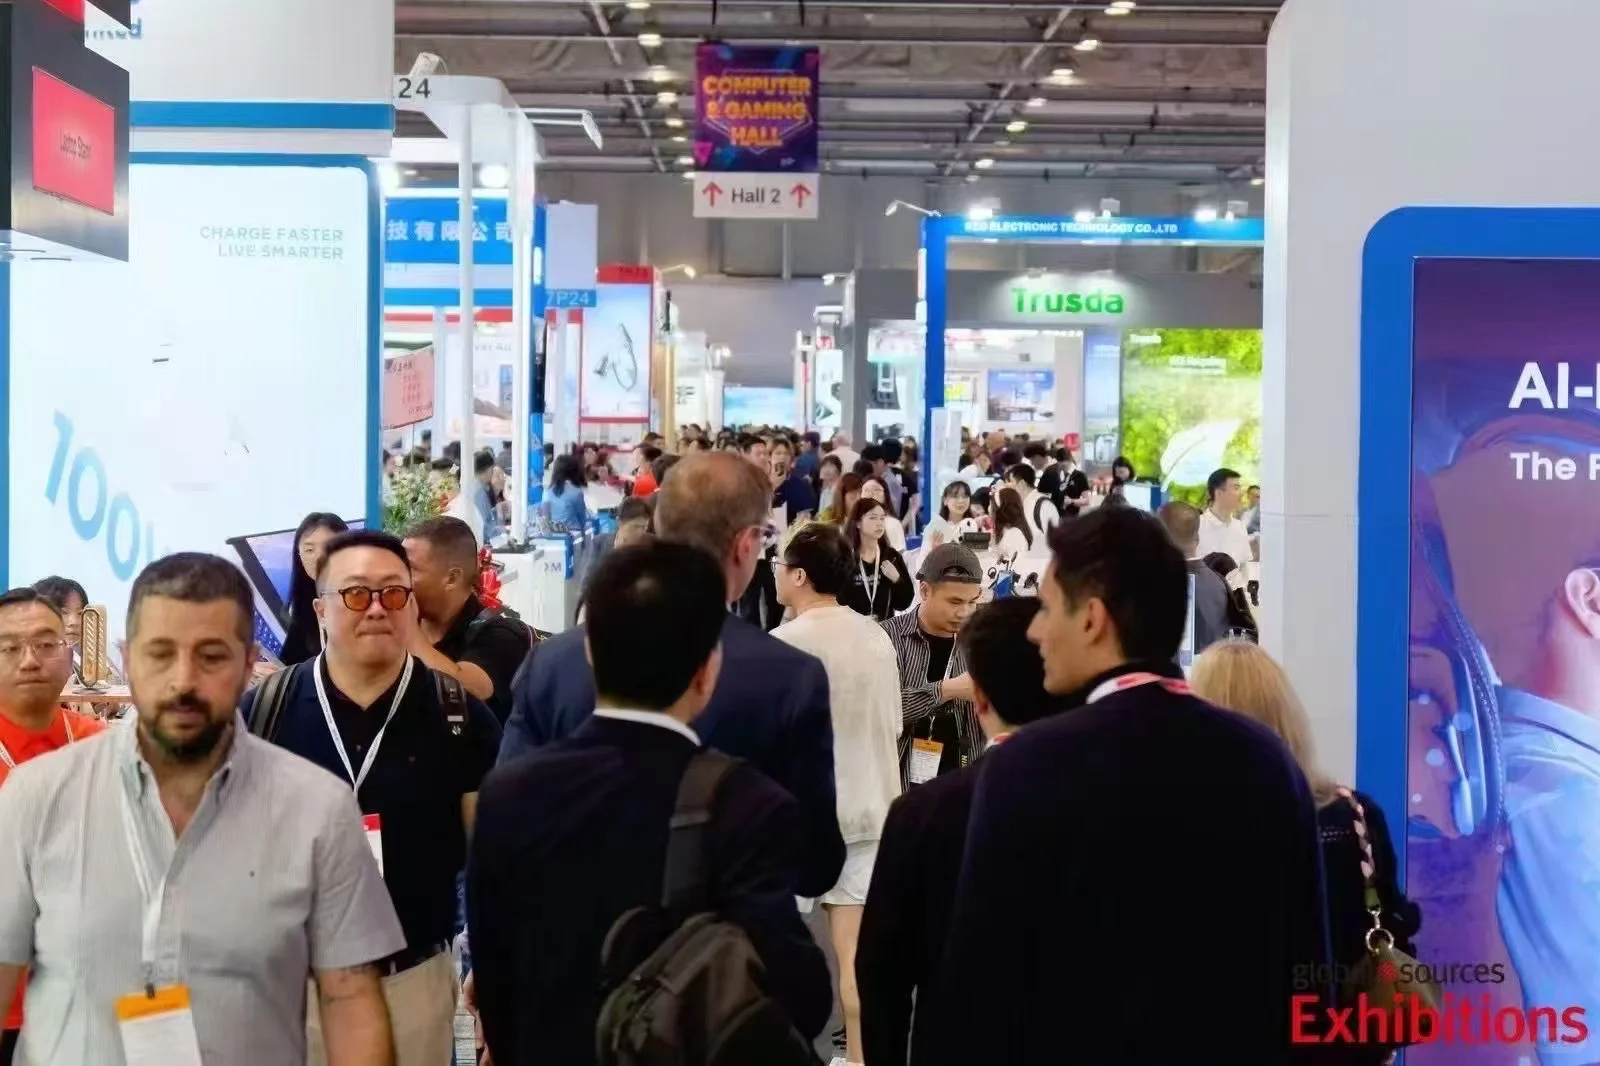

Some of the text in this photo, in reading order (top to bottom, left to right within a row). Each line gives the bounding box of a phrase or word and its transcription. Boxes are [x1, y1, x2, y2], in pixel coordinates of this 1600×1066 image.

[398, 77, 431, 99] 24
[703, 76, 812, 95] COMPUTER
[725, 102, 807, 119] GAMING
[730, 127, 783, 146] HALL
[731, 187, 781, 204] Hall 2
[199, 226, 344, 242] CHARGE FASTER
[990, 221, 1058, 233] ELECTRONIC
[1060, 222, 1133, 233] TECHNOLOGY
[218, 243, 344, 259] LIVE SMARTER
[1012, 287, 1125, 315] Trusda
[1508, 361, 1600, 409] AI-
[1509, 451, 1577, 481] The
